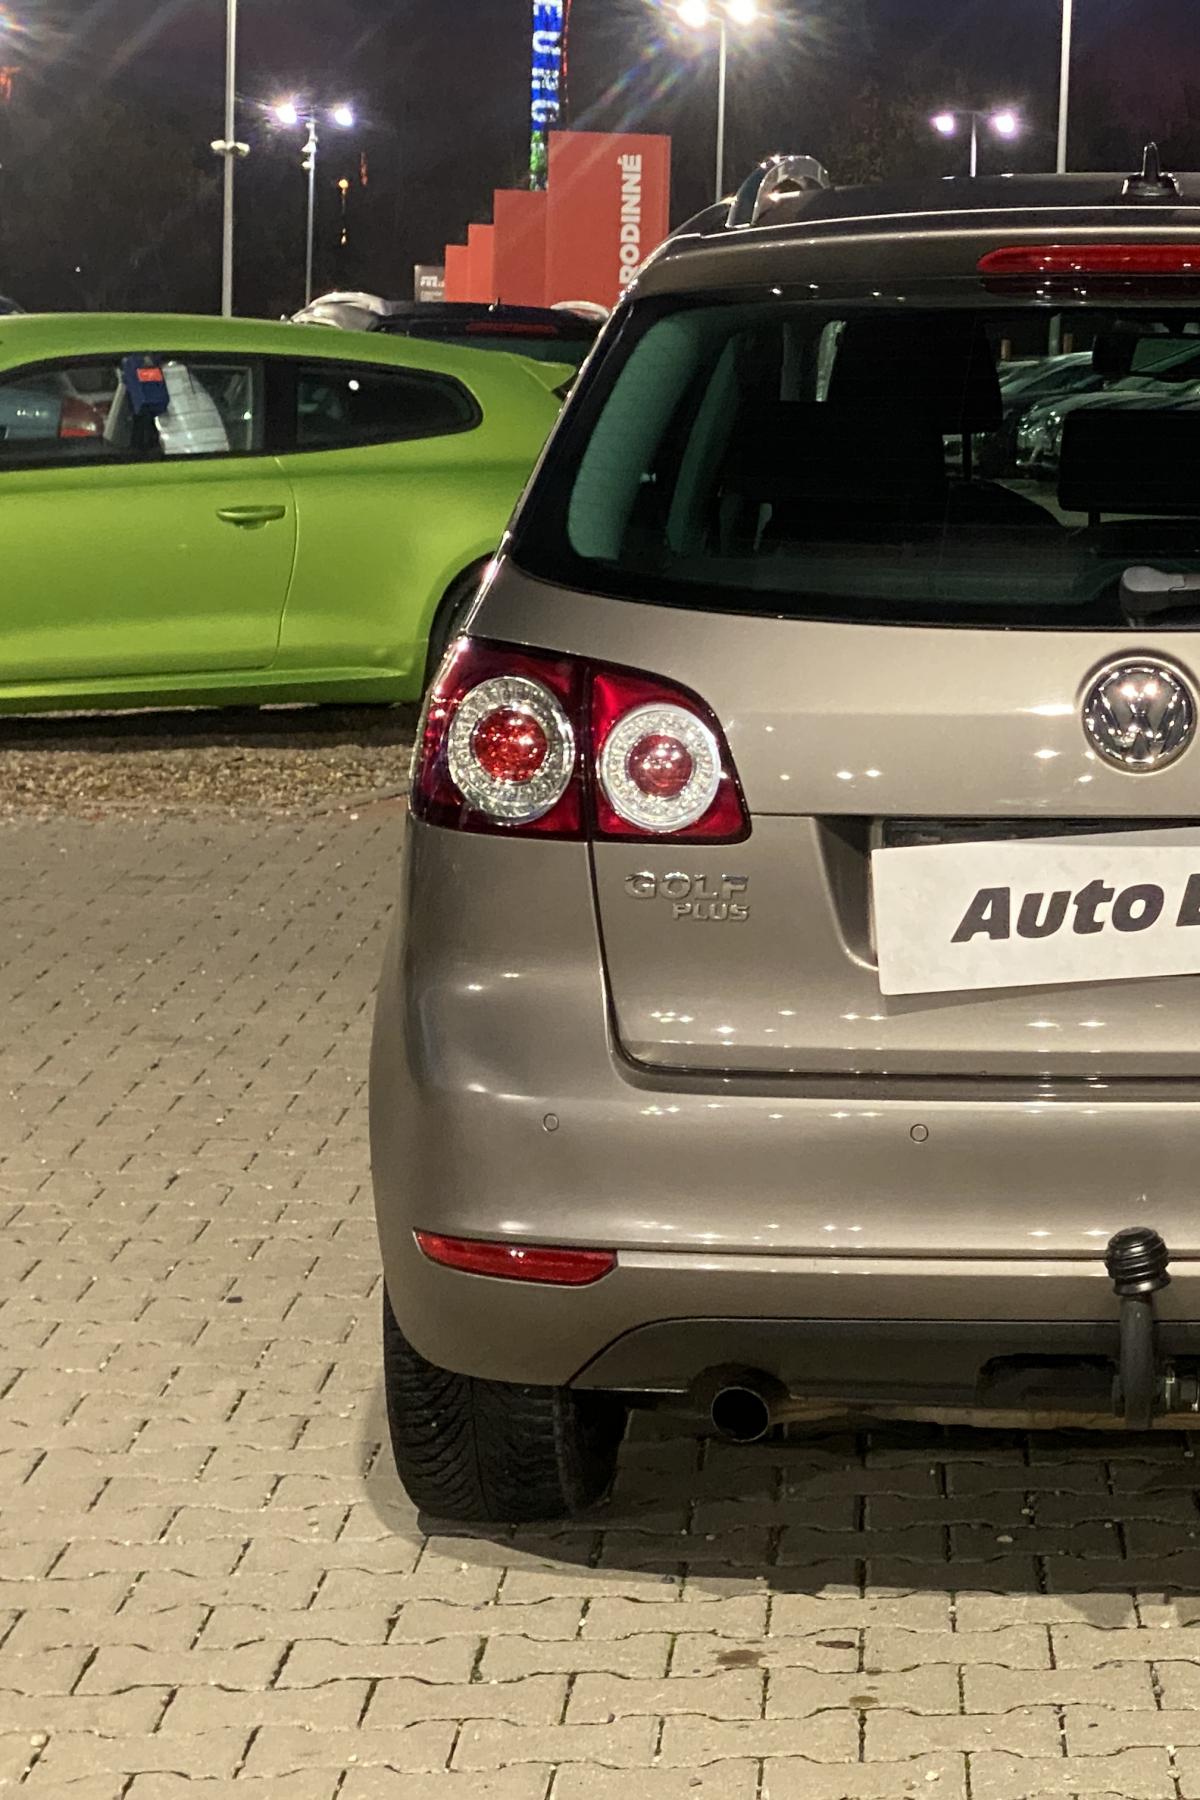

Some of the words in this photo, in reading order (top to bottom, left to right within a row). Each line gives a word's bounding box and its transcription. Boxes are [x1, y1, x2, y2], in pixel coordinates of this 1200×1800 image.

[618, 154, 642, 284] RODINNÉ
[624, 871, 749, 900] GOLF
[672, 902, 749, 921] PLUS
[950, 879, 1165, 943] Auto
